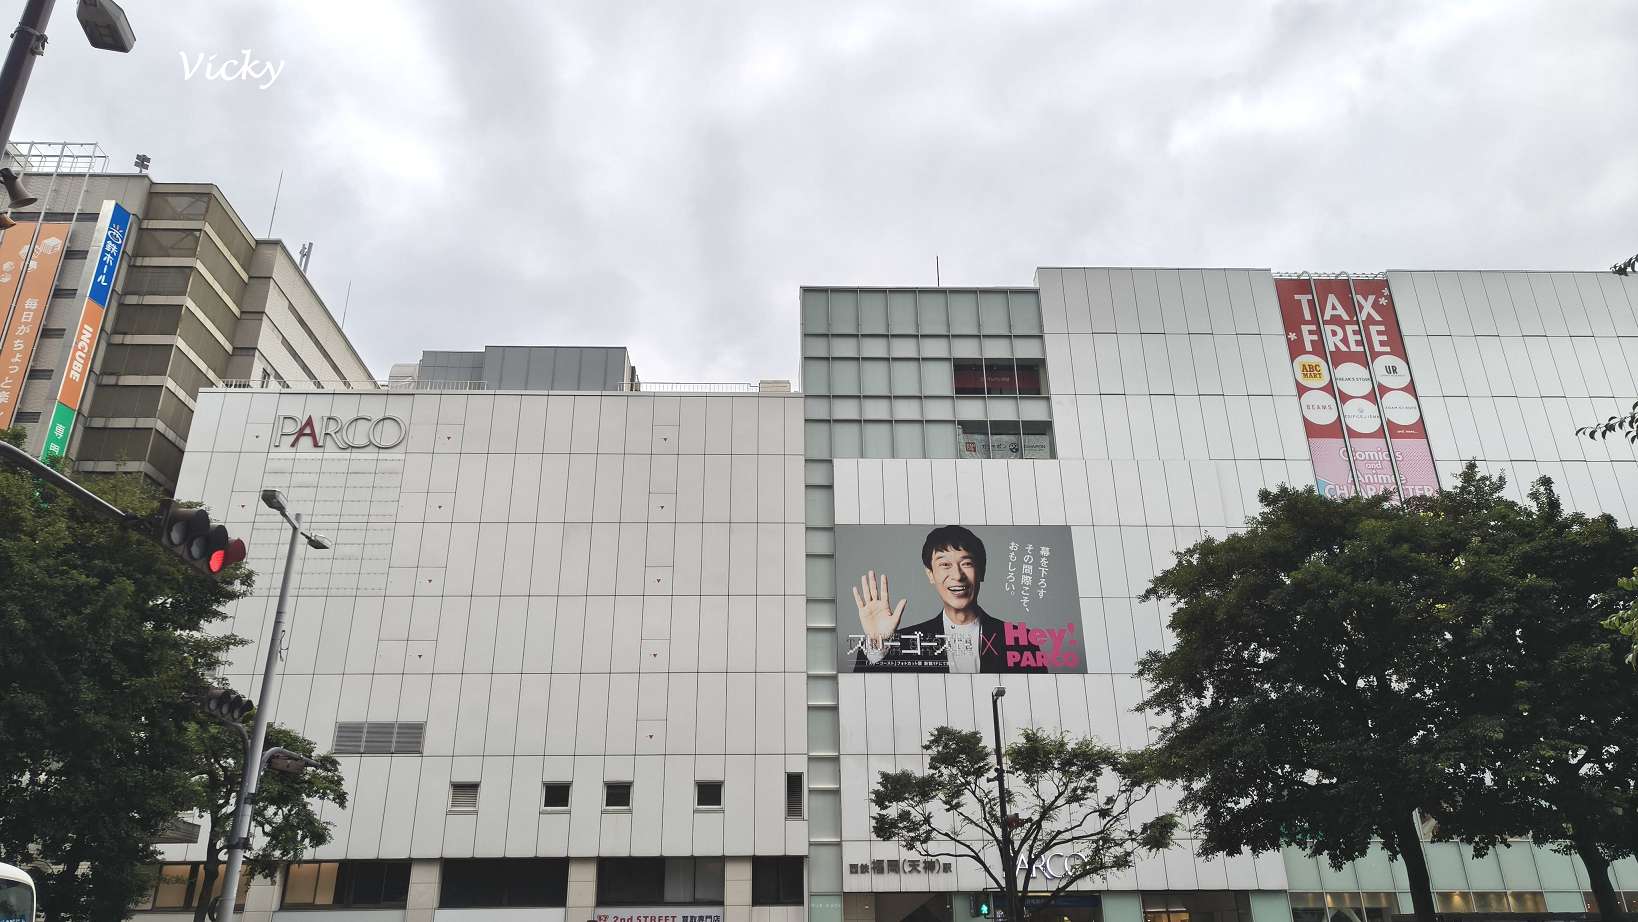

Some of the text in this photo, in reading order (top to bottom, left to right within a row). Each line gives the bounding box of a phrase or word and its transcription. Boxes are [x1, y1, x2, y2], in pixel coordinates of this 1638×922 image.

[1294, 294, 1383, 320] TAX
[1301, 325, 1391, 352] FREE
[69, 324, 94, 382] INCUBE
[1302, 364, 1321, 372] ABC
[1385, 365, 1398, 375] UR
[274, 415, 406, 449] PARCO
[1340, 448, 1403, 461] Comics
[1347, 470, 1407, 484] Anime
[1004, 622, 1078, 656] Hey!
[1006, 651, 1078, 668] PARCO
[1004, 853, 1088, 879] ARCO
